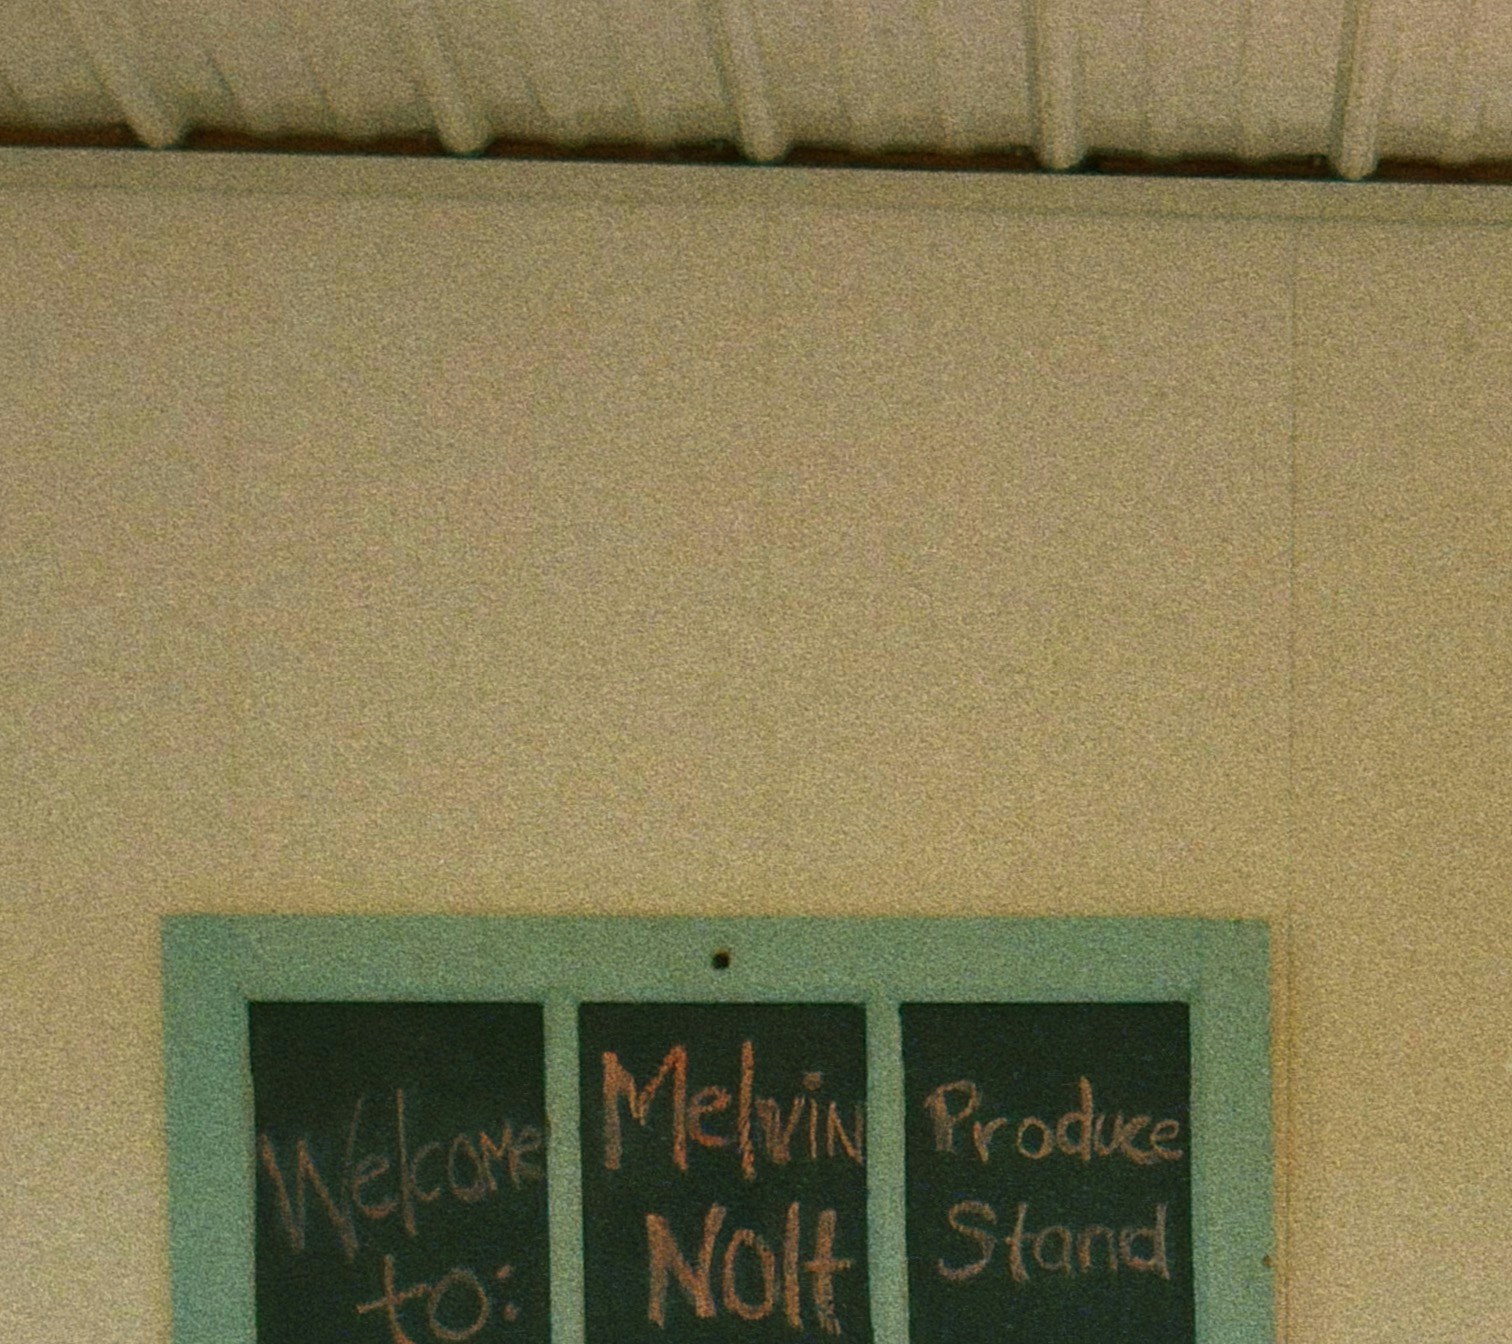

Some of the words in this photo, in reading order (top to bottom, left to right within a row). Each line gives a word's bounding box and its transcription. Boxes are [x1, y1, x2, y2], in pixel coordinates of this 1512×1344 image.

[602, 1040, 865, 1181] Melvin
[923, 1075, 1184, 1165] Produce
[646, 1202, 854, 1336] Nolt
[938, 1202, 1171, 1283] Stand
